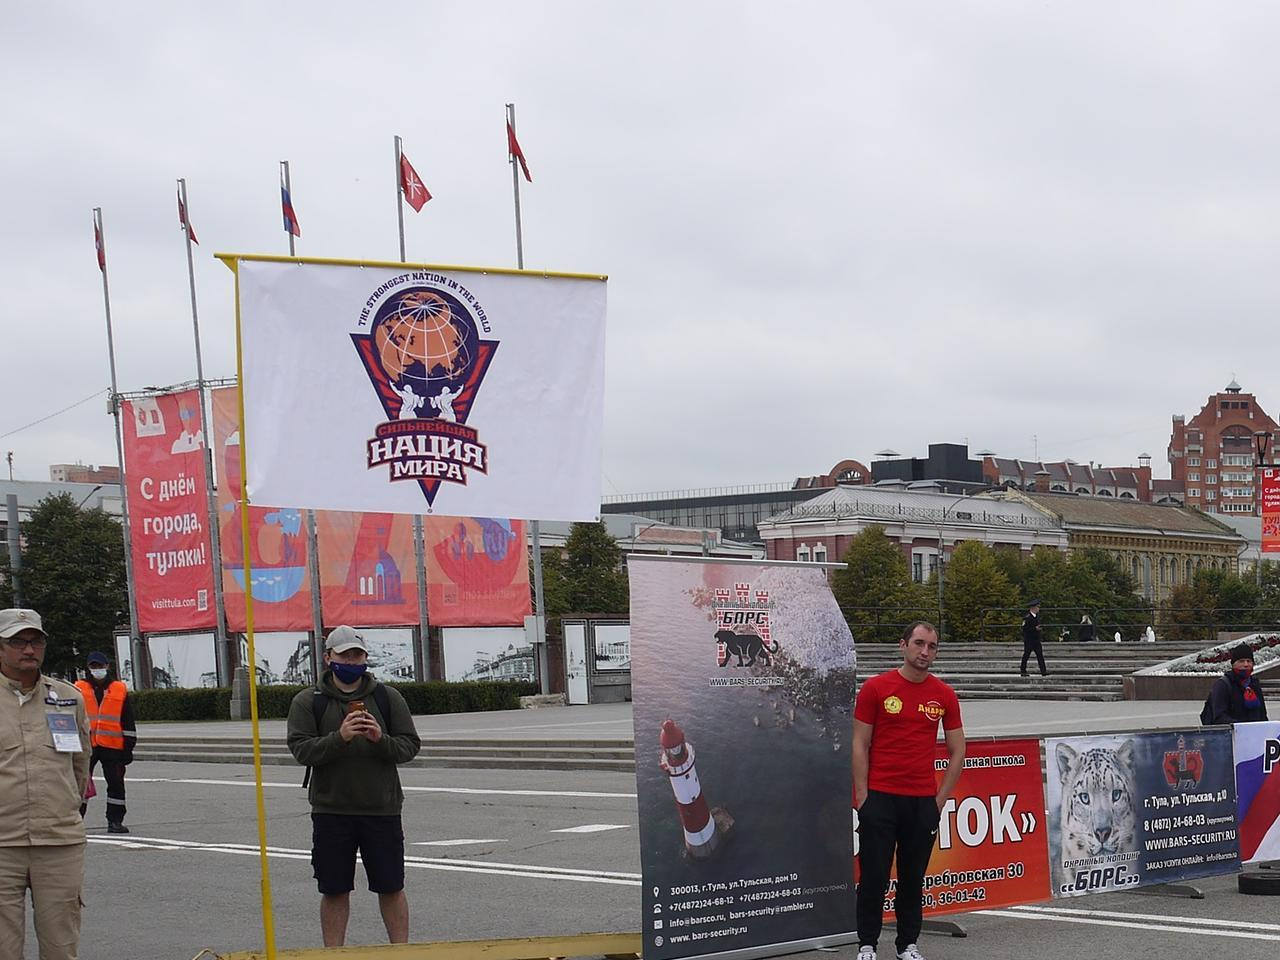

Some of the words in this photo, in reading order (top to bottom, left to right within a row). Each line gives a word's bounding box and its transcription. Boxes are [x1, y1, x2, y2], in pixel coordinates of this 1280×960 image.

[358, 307, 370, 327] THE
[367, 273, 410, 308] STRONGEST
[412, 272, 447, 284] NATION
[447, 279, 459, 290] IN
[458, 285, 476, 303] THE
[472, 301, 492, 333] WORLD
[378, 420, 476, 440] СИЛЬНЕЙШАЯ
[370, 435, 483, 469] НАЦИЯ
[393, 460, 463, 480] МИРА
[140, 477, 153, 500] С
[159, 473, 196, 501] днём
[143, 512, 202, 539] города,
[146, 543, 206, 576] туляки!
[151, 596, 196, 610] visittula.com
[992, 754, 1026, 768] школа
[1144, 820, 1150, 831] 8
[1151, 817, 1172, 833] (4872)
[1173, 814, 1205, 828] 24-68-03
[1145, 829, 1236, 851] WWW.BARS-SECURITY.RU
[1007, 863, 1024, 877] 30
[670, 884, 700, 895] 300013,
[702, 883, 728, 892] г.Тула,
[775, 875, 788, 884] дом
[789, 873, 798, 881] 10
[669, 896, 734, 911] +7(4872)24-68-12
[938, 888, 985, 905] 36-01-42
[670, 935, 691, 943] www.
[692, 926, 748, 940] bars-security.ru
